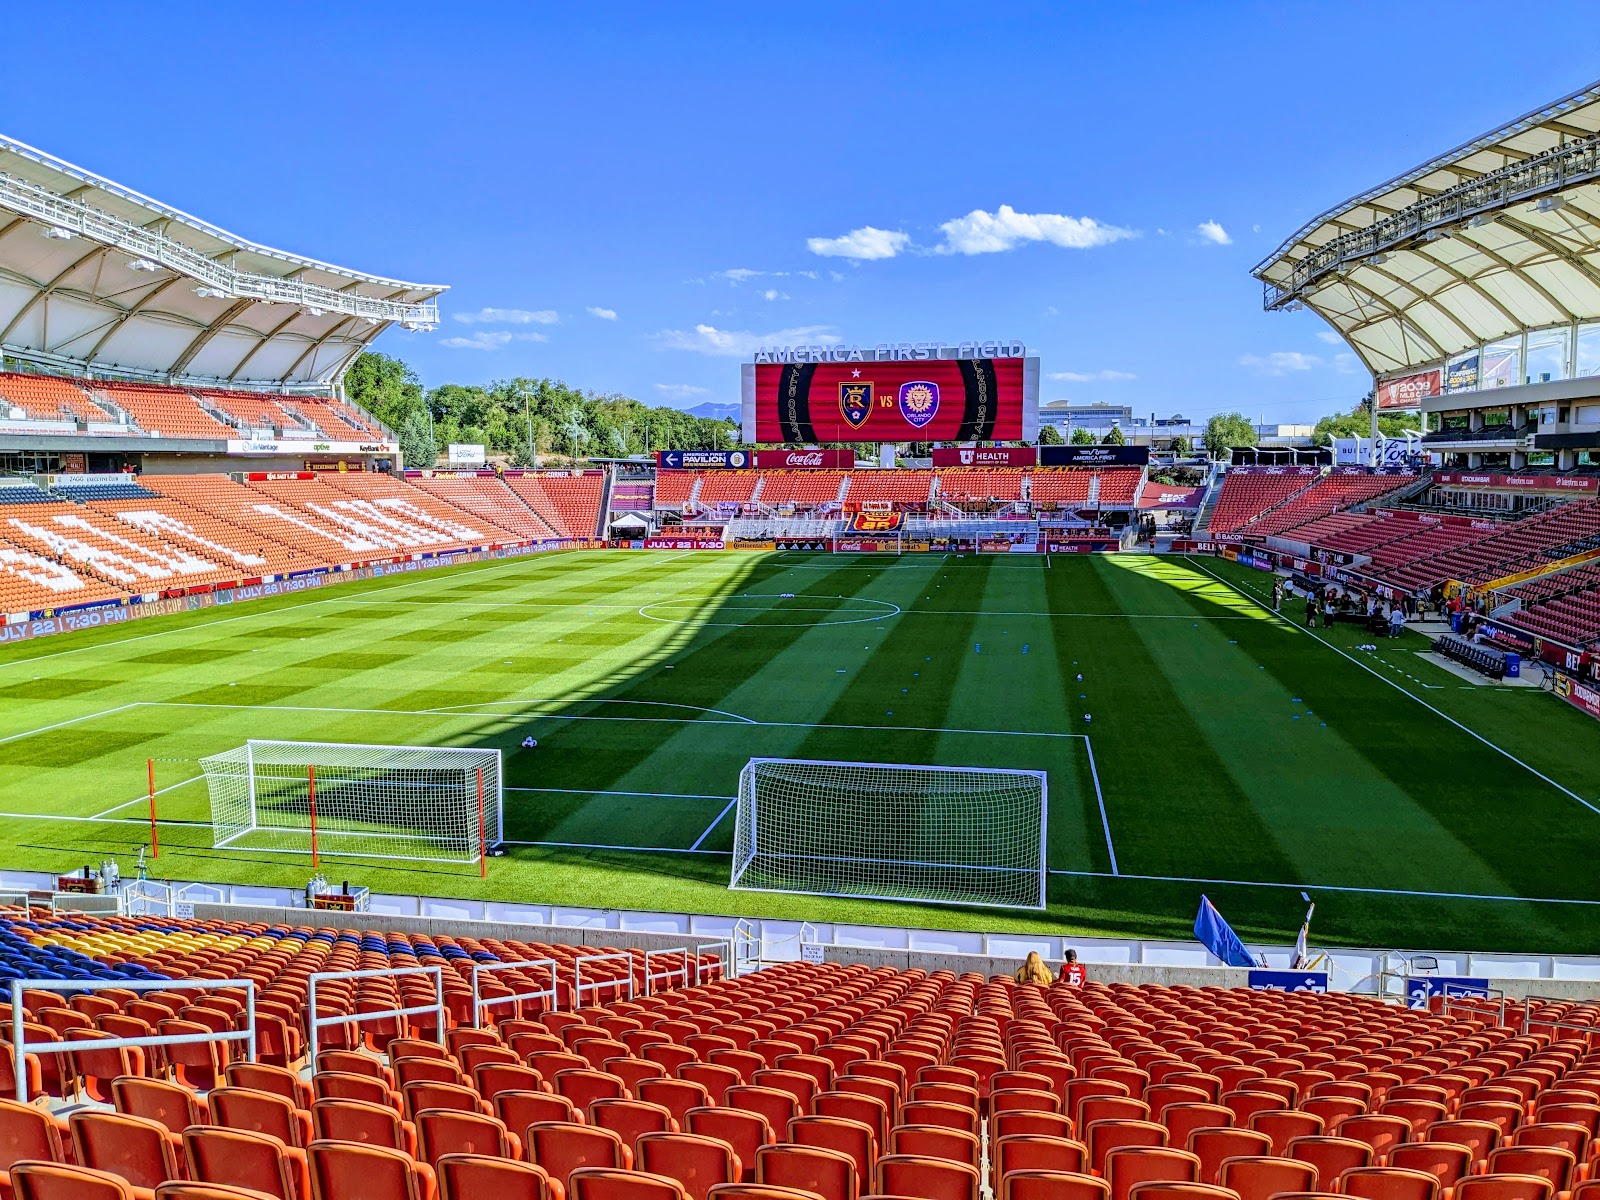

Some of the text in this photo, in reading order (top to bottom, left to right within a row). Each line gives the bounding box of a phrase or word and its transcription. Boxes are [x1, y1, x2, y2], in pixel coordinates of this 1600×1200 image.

[756, 340, 1025, 363] AMERICA FIRST FIELD
[1400, 382, 1430, 392] 2009
[1416, 390, 1430, 398] CUP
[880, 396, 893, 408] VS
[250, 443, 278, 452] LifeVantage
[458, 450, 476, 458] Ford
[786, 452, 824, 466] Coca-Cola
[976, 452, 1009, 460] HEALTH
[1072, 454, 1098, 462] AMERICA
[288, 472, 298, 480] LAKE
[1232, 467, 1248, 475] Ford
[1266, 467, 1282, 475] Ford
[1298, 467, 1315, 475] Ford
[1343, 467, 1360, 475] Ford
[508, 548, 522, 556] JULY
[534, 544, 546, 552] 7:30
[547, 542, 560, 550] PM
[560, 540, 603, 550] LEAGUES CUP
[454, 554, 471, 564] LEAGUES
[471, 553, 480, 562] CUP
[386, 558, 452, 574] JULY 22 7:30 PM
[322, 574, 342, 586] LEAGUES
[343, 572, 354, 582] CUP
[237, 577, 321, 600] JULY 26 7:30 PM
[204, 595, 212, 605] VS
[130, 602, 165, 619] LEAGUES
[166, 598, 182, 614] CUP
[0, 608, 128, 641] ULY 22 7:30 PM
[1068, 972, 1081, 986] 15
